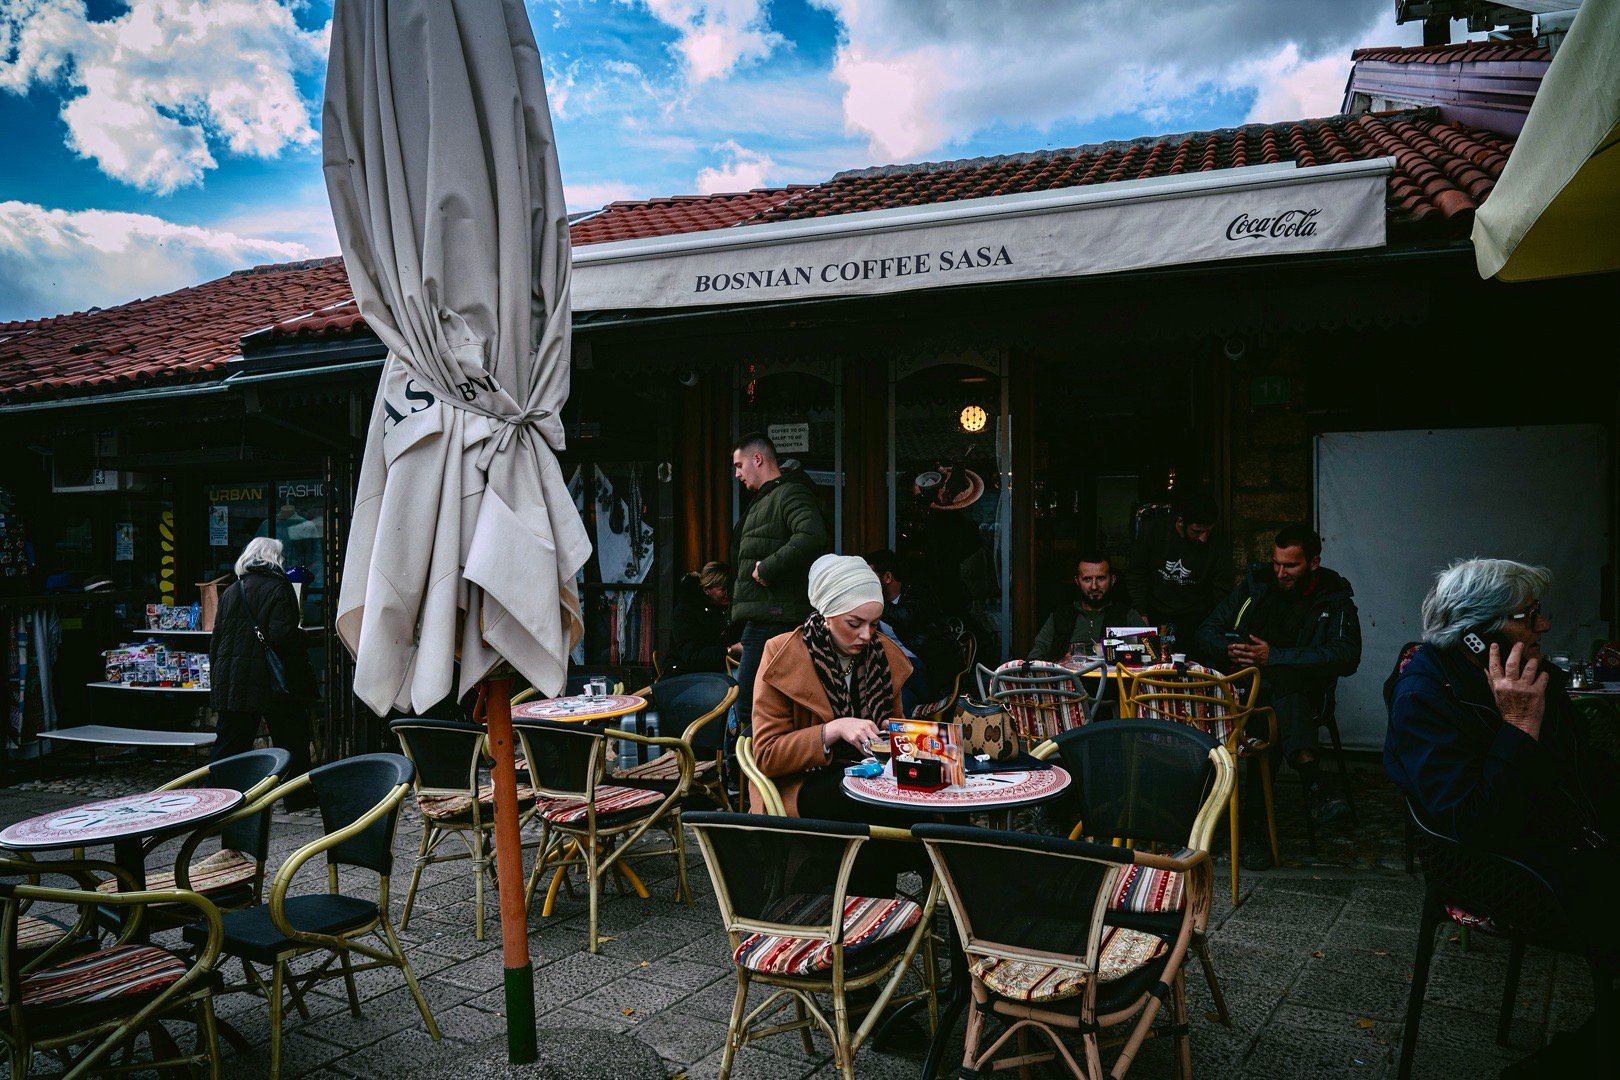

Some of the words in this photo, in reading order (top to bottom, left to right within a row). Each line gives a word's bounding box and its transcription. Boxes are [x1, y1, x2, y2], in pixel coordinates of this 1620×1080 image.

[1225, 208, 1323, 241] Coca-Cola
[694, 266, 813, 293] BOSNIAN
[820, 253, 931, 283] COFFEE
[939, 245, 1014, 272] SASA
[209, 488, 262, 502] URBAN
